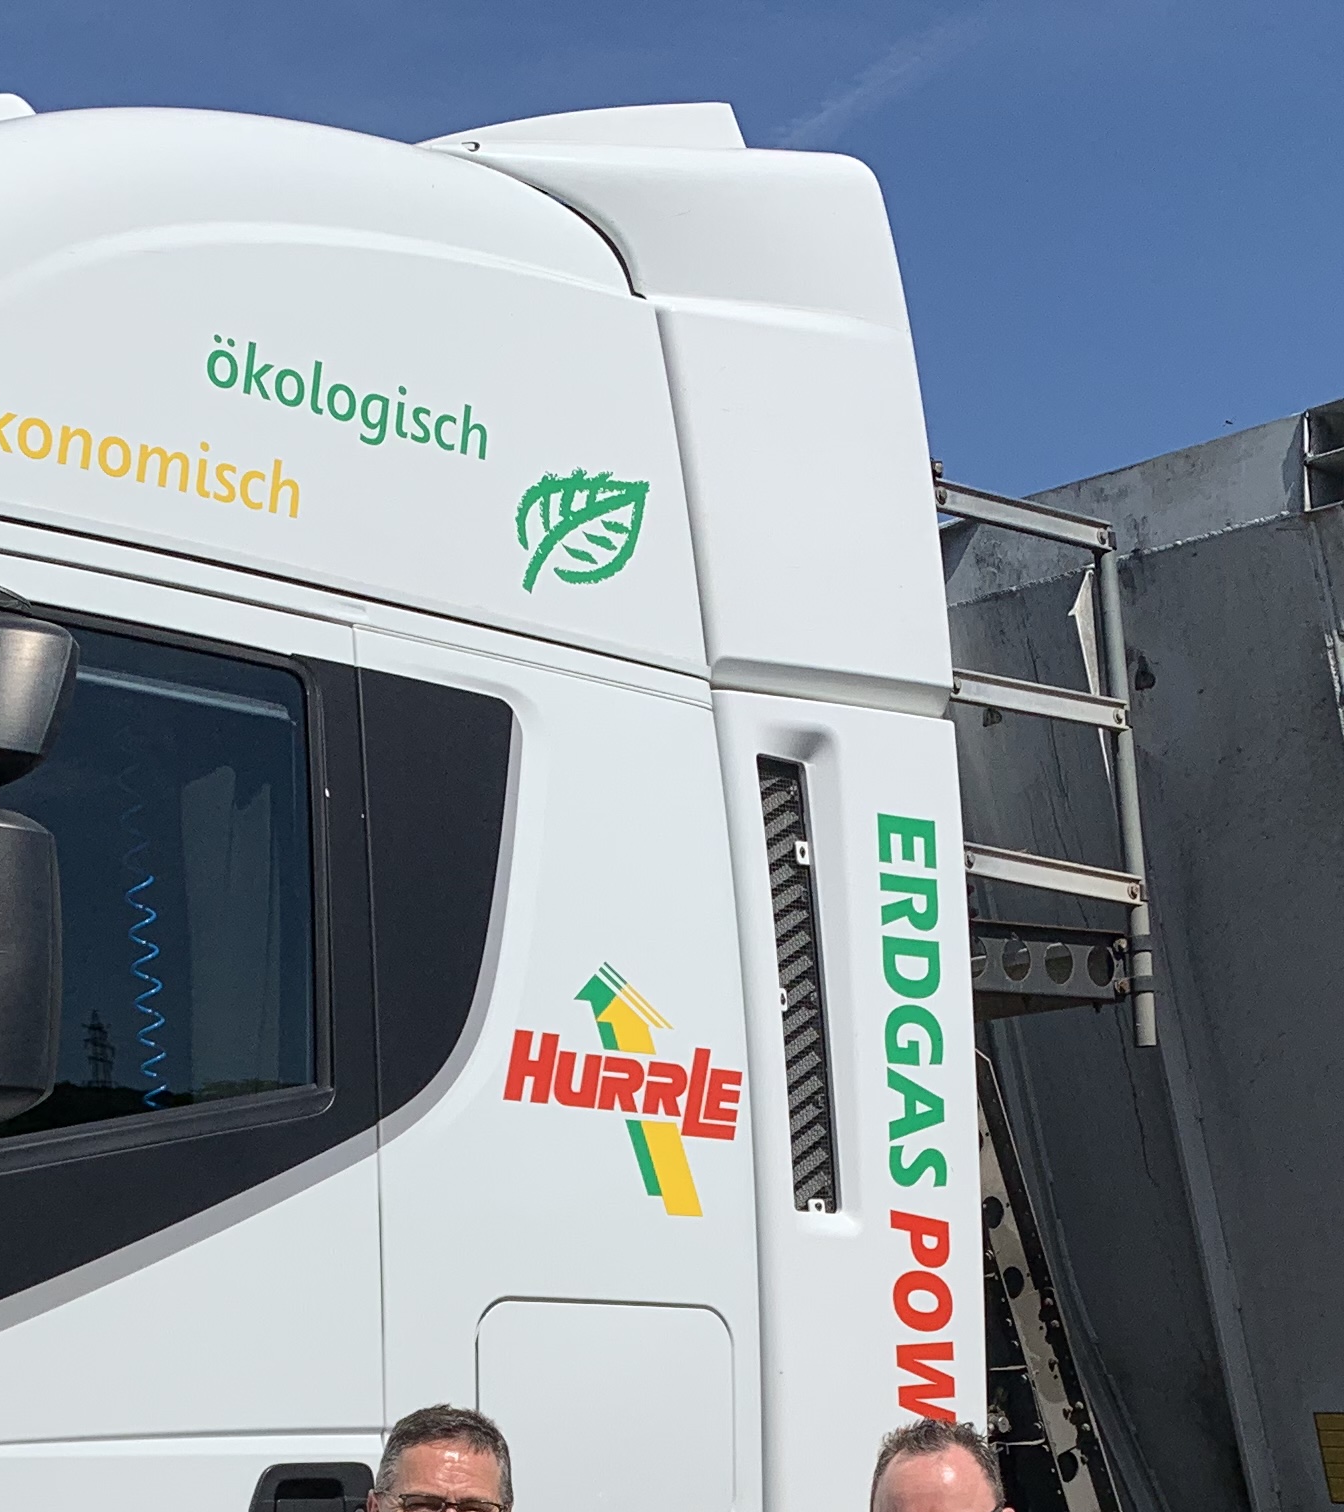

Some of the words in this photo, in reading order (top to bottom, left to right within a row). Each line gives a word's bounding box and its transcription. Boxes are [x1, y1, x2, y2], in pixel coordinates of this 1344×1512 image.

[206, 333, 489, 461] ökologisch
[877, 813, 948, 1189] ERDGAS
[503, 1029, 743, 1141] HURRLE
